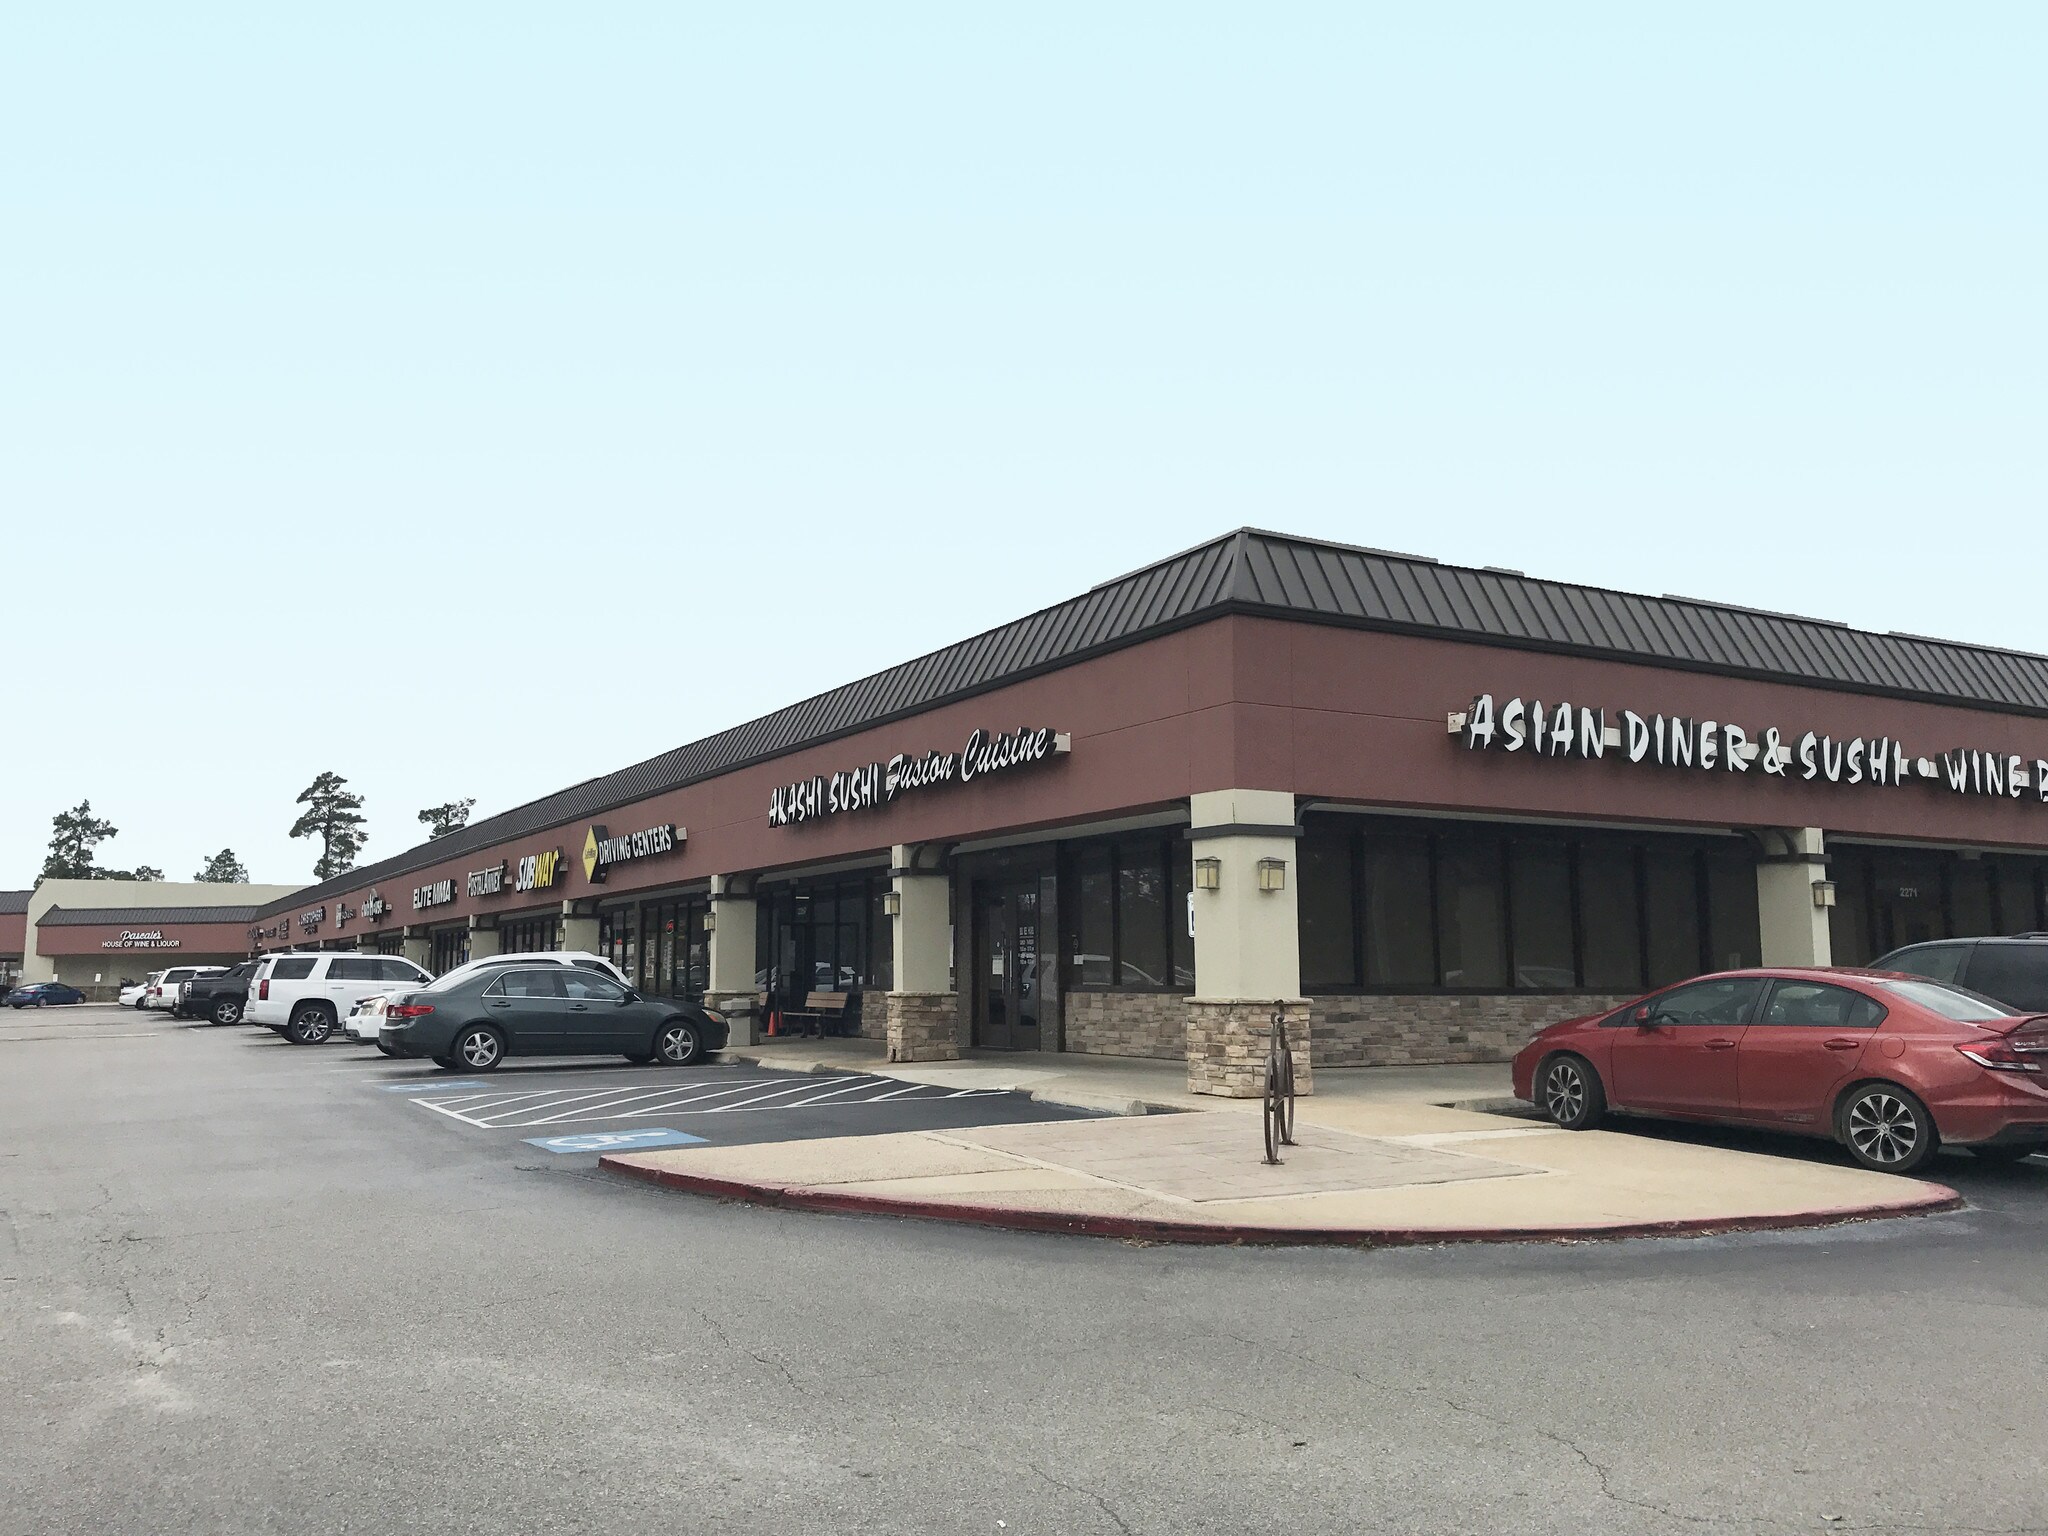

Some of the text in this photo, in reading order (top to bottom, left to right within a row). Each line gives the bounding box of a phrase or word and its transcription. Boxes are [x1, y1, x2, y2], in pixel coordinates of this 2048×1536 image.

[1470, 694, 1604, 758] ASIAN
[1624, 709, 1749, 772] DINER
[1763, 726, 1786, 777] &
[1800, 730, 1901, 786] SUSHI
[1944, 748, 2022, 798] WINE
[768, 727, 1048, 825] AKASHI SUSHI Fusion Cuisine
[598, 823, 673, 866] DRIVING CENTERS
[515, 850, 560, 892] SUBWAY
[412, 884, 433, 909] ELITE
[432, 879, 451, 906] MMA
[1900, 887, 1918, 898] 2271
[101, 940, 123, 949] HOUSE
[123, 940, 133, 949] OF
[134, 940, 150, 949] WINE
[156, 940, 180, 948] LIQUOR
